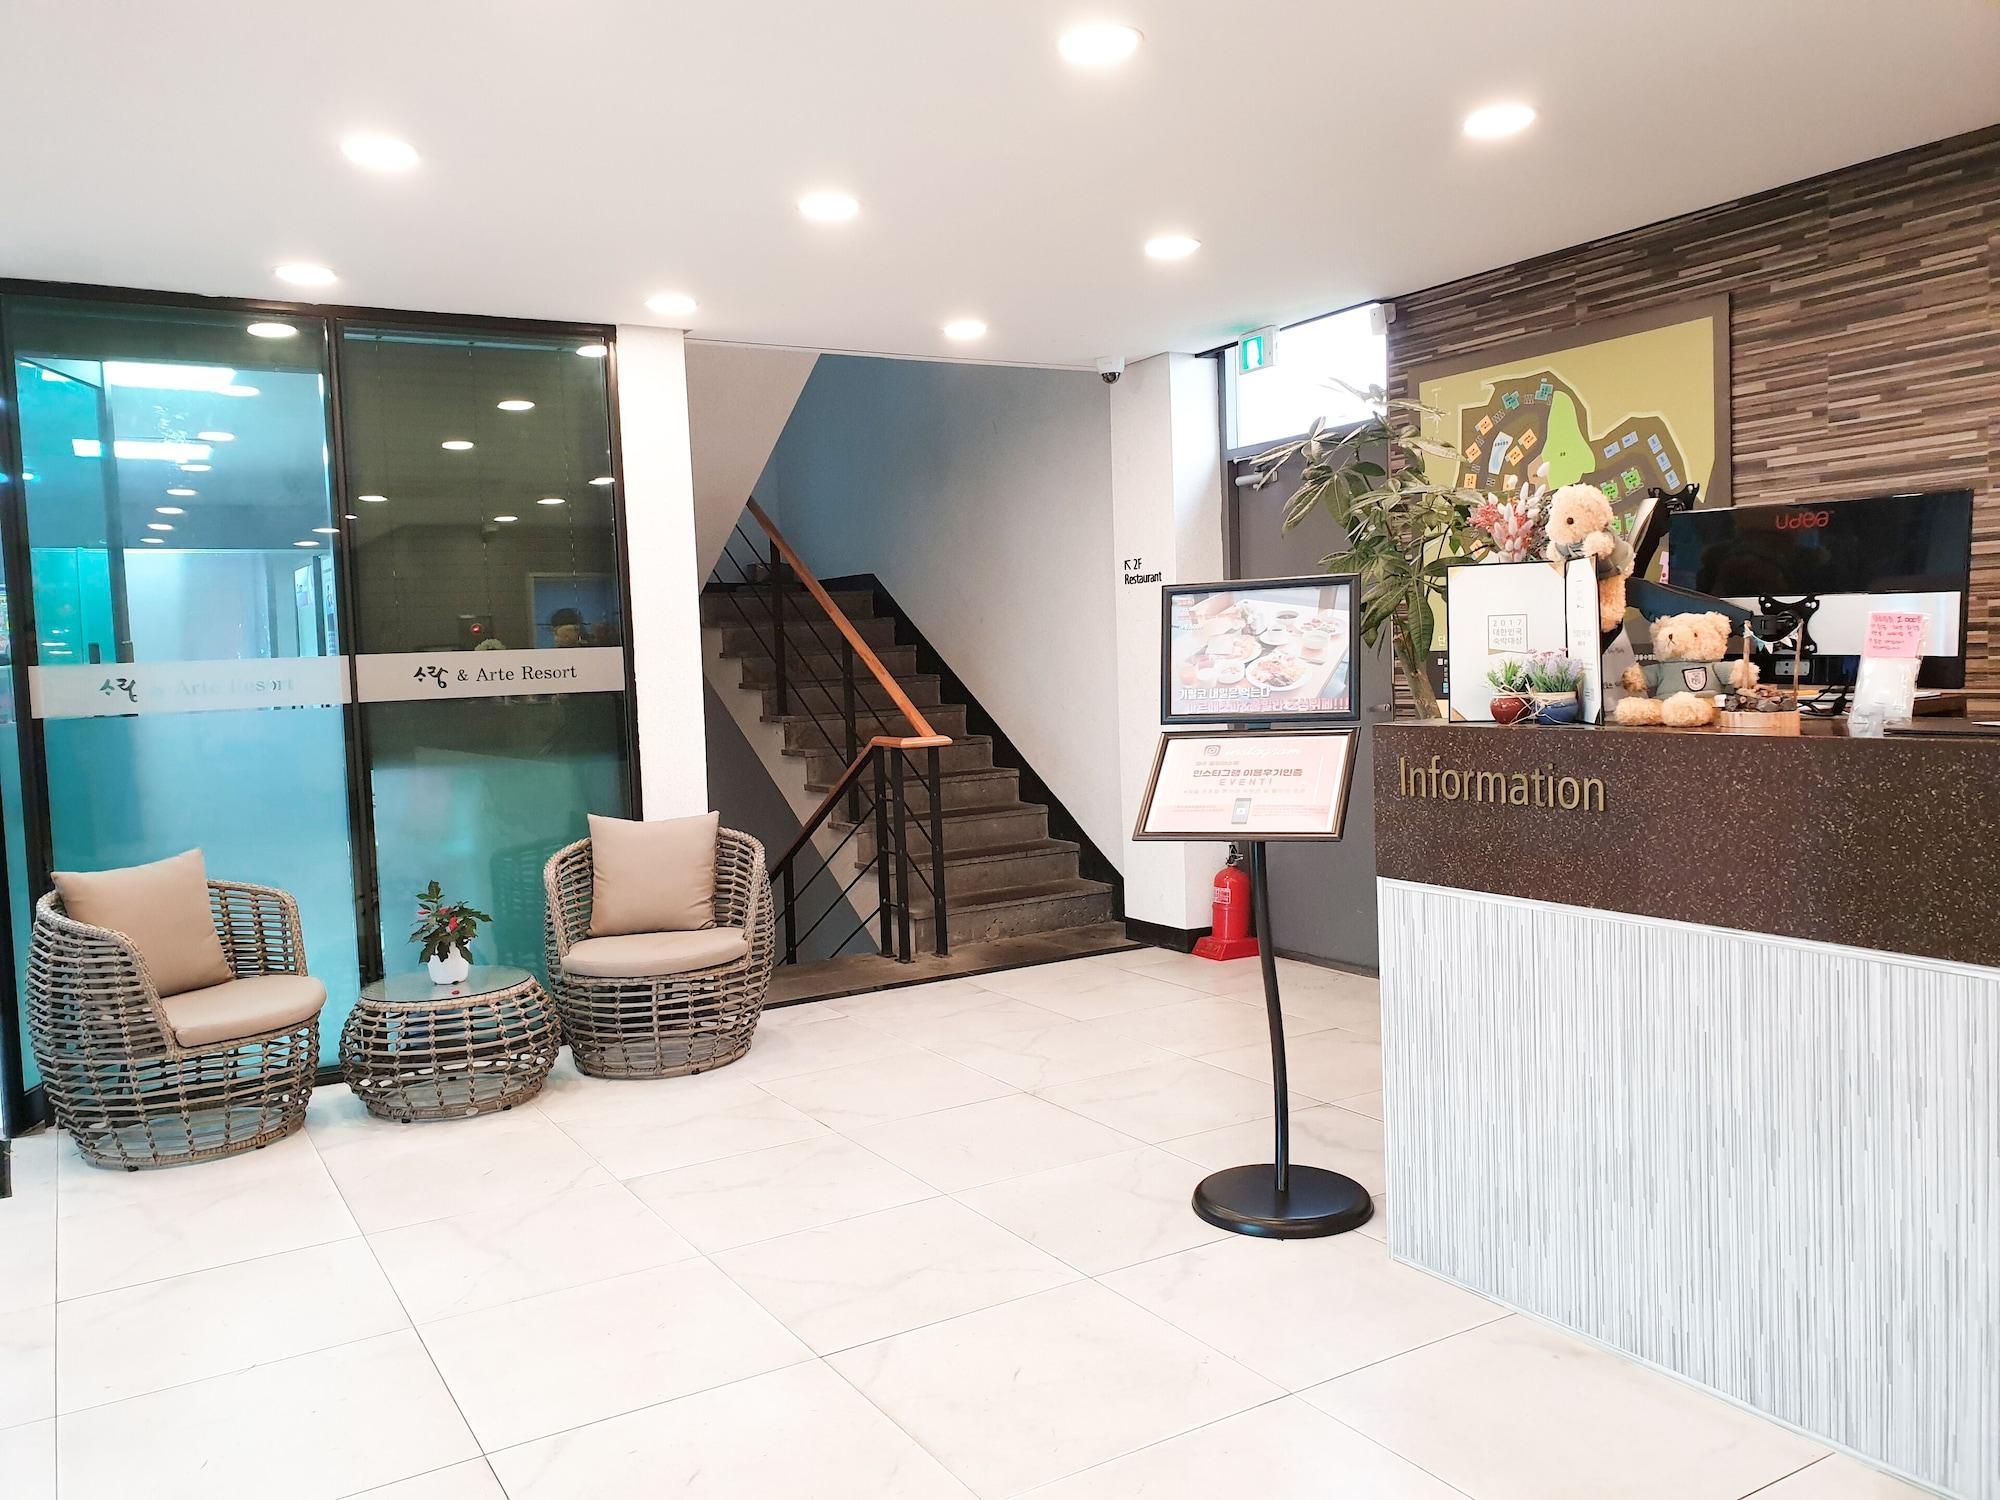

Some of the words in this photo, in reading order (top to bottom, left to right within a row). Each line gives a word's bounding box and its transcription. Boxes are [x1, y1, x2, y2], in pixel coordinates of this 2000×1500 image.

[1133, 557, 1142, 570] 2F
[1124, 571, 1162, 585] Restaurant
[1492, 619, 1522, 627] 2017
[1492, 628, 1523, 637] 대한민국
[457, 669, 469, 682] &
[476, 668, 515, 682] Arte
[522, 665, 578, 680] Resort
[1219, 778, 1273, 786] EVENT!
[1399, 755, 1606, 812] Information
